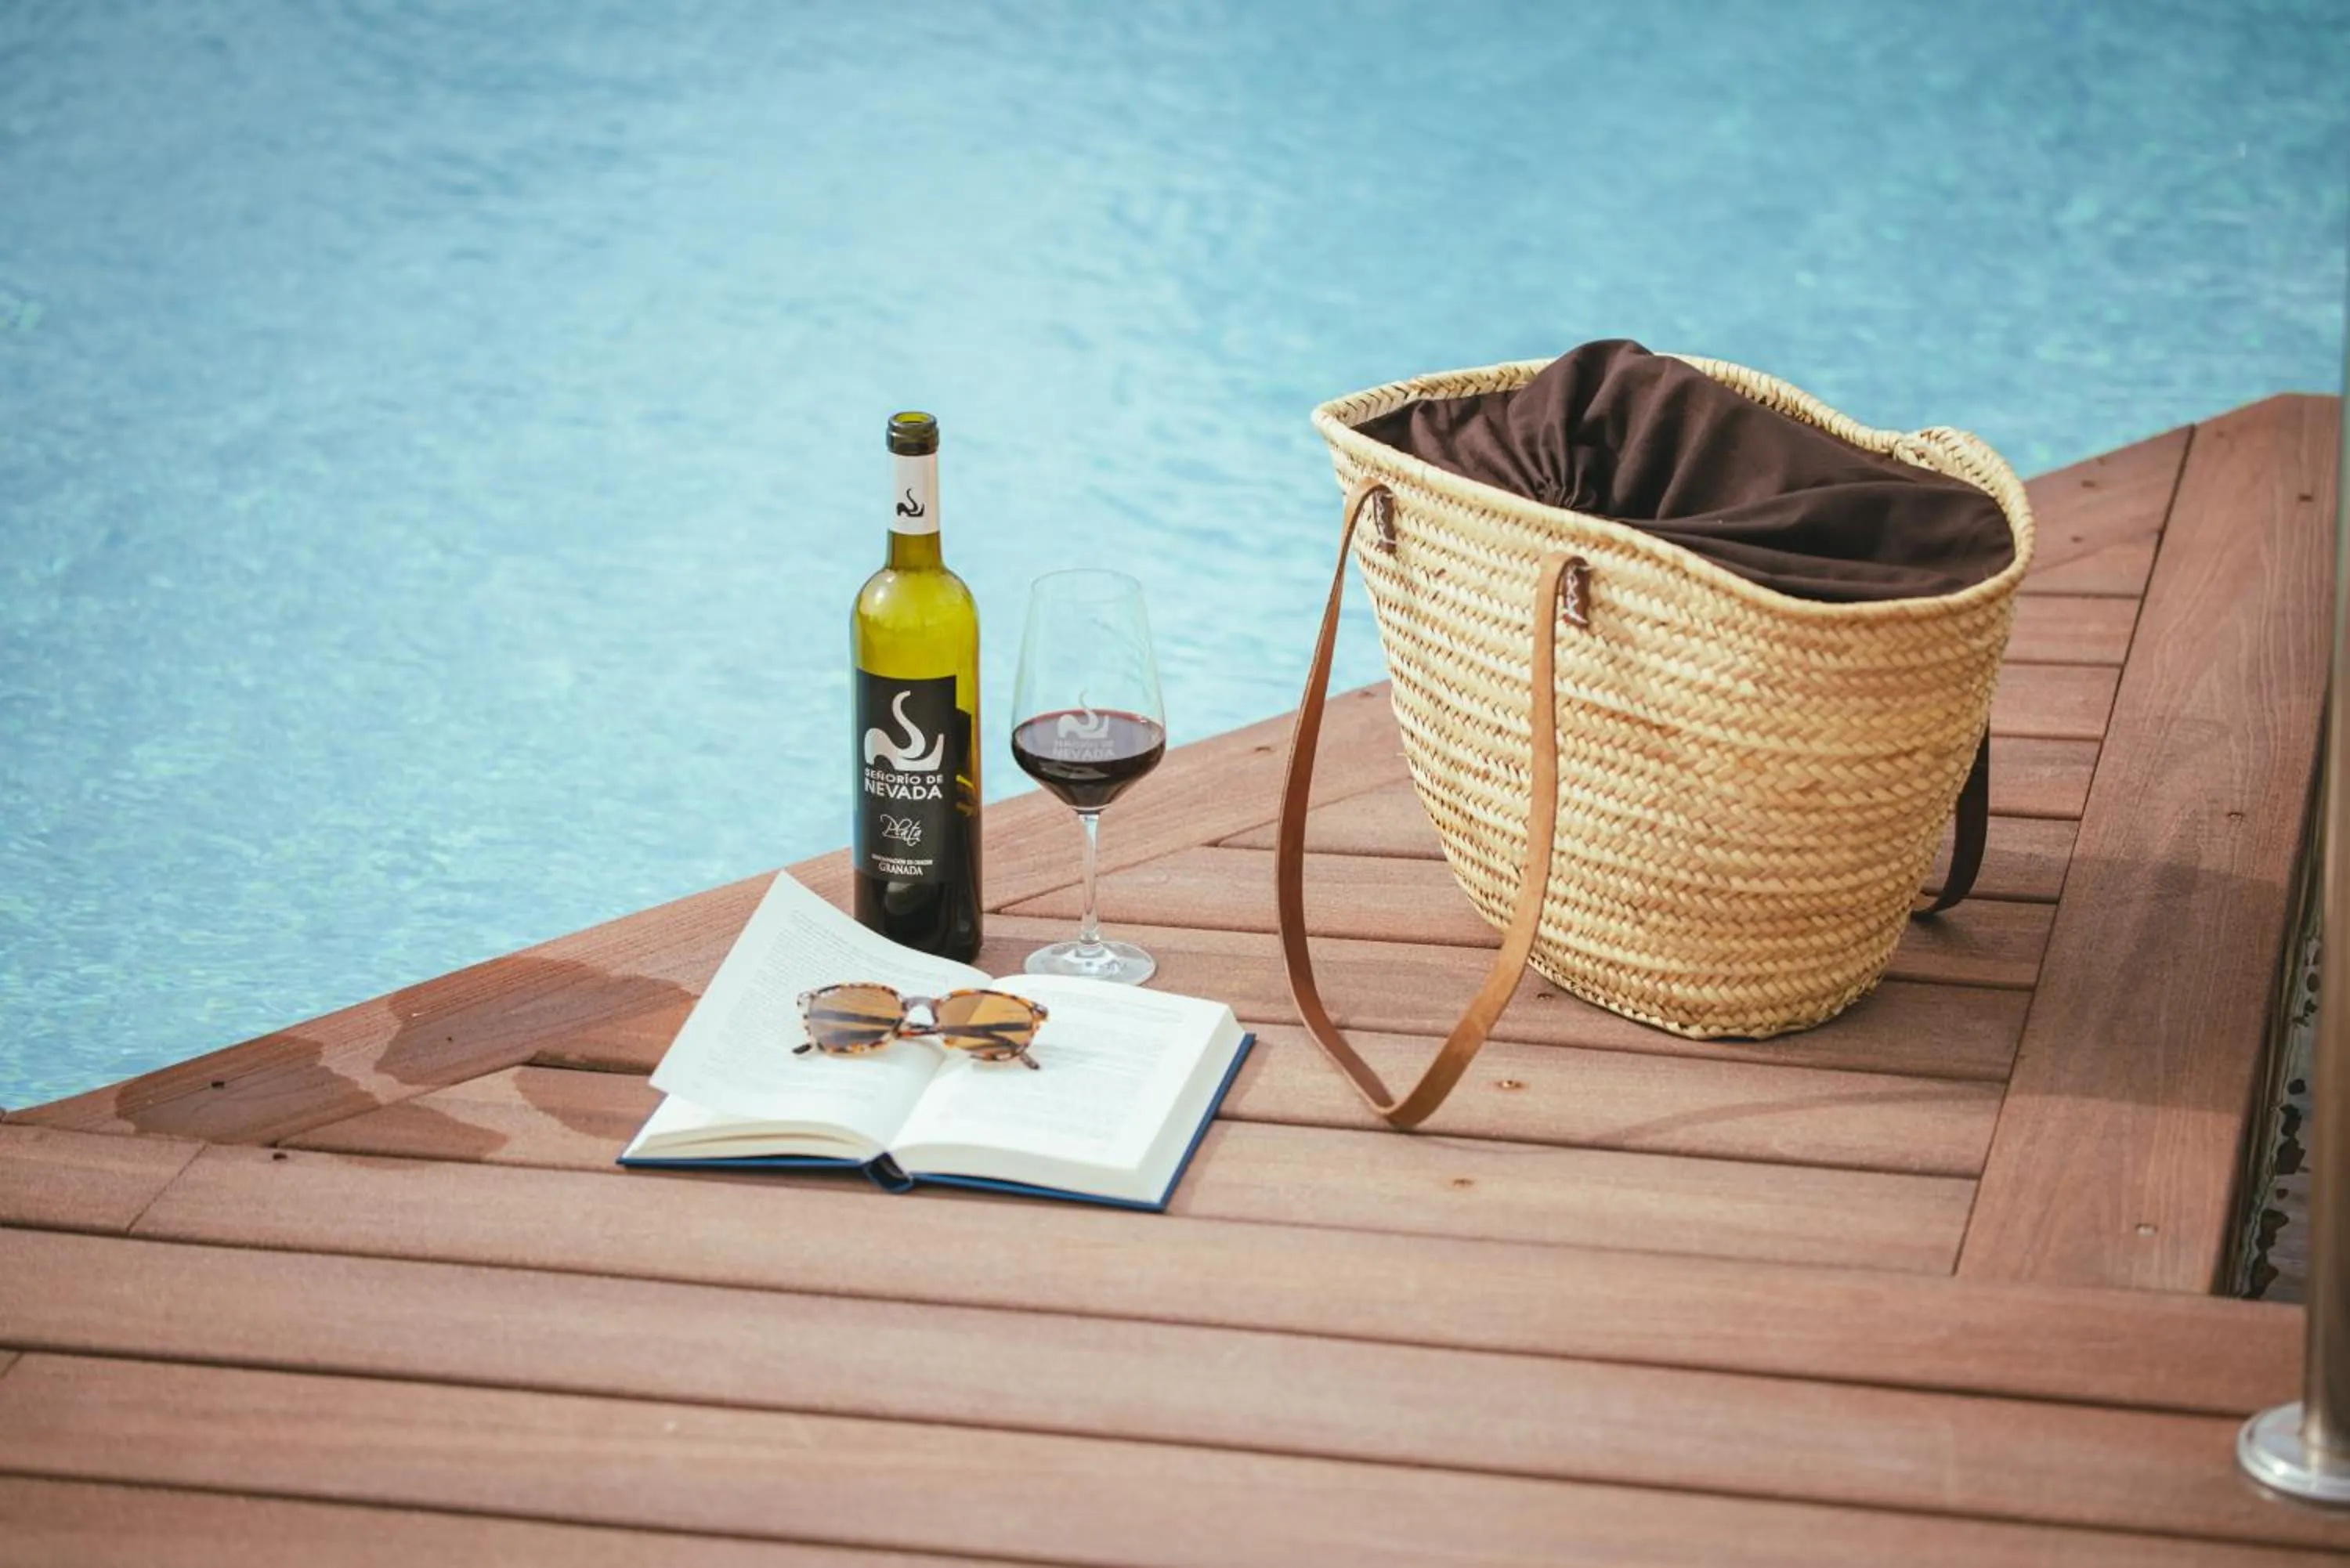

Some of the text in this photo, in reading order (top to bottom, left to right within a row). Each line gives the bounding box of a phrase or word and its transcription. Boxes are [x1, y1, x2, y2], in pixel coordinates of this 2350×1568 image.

[1053, 746, 1115, 761] NEVADA
[926, 775, 943, 784] DE
[865, 779, 942, 800] NEVADA
[879, 862, 924, 876] GRANADA
